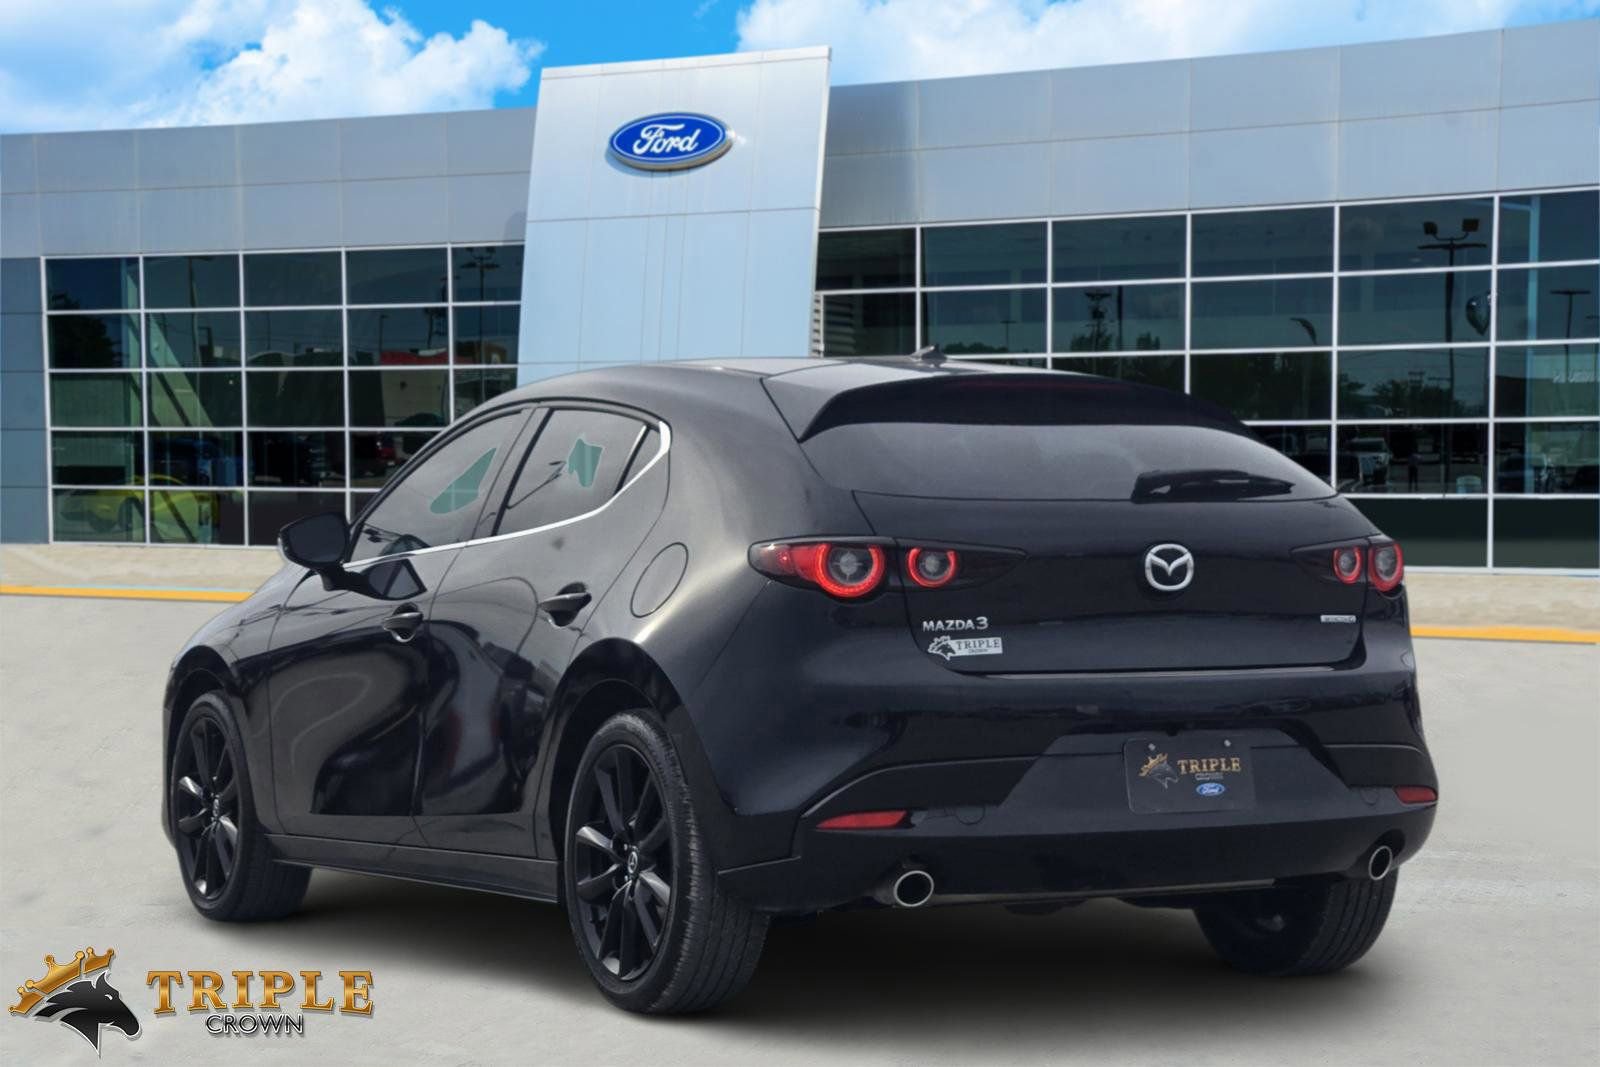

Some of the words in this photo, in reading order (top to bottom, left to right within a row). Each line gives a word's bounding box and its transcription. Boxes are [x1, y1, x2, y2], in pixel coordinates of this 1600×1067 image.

[633, 123, 701, 155] Ford
[956, 639, 1001, 650] TRIPLE
[1177, 758, 1241, 774] TRIPLE
